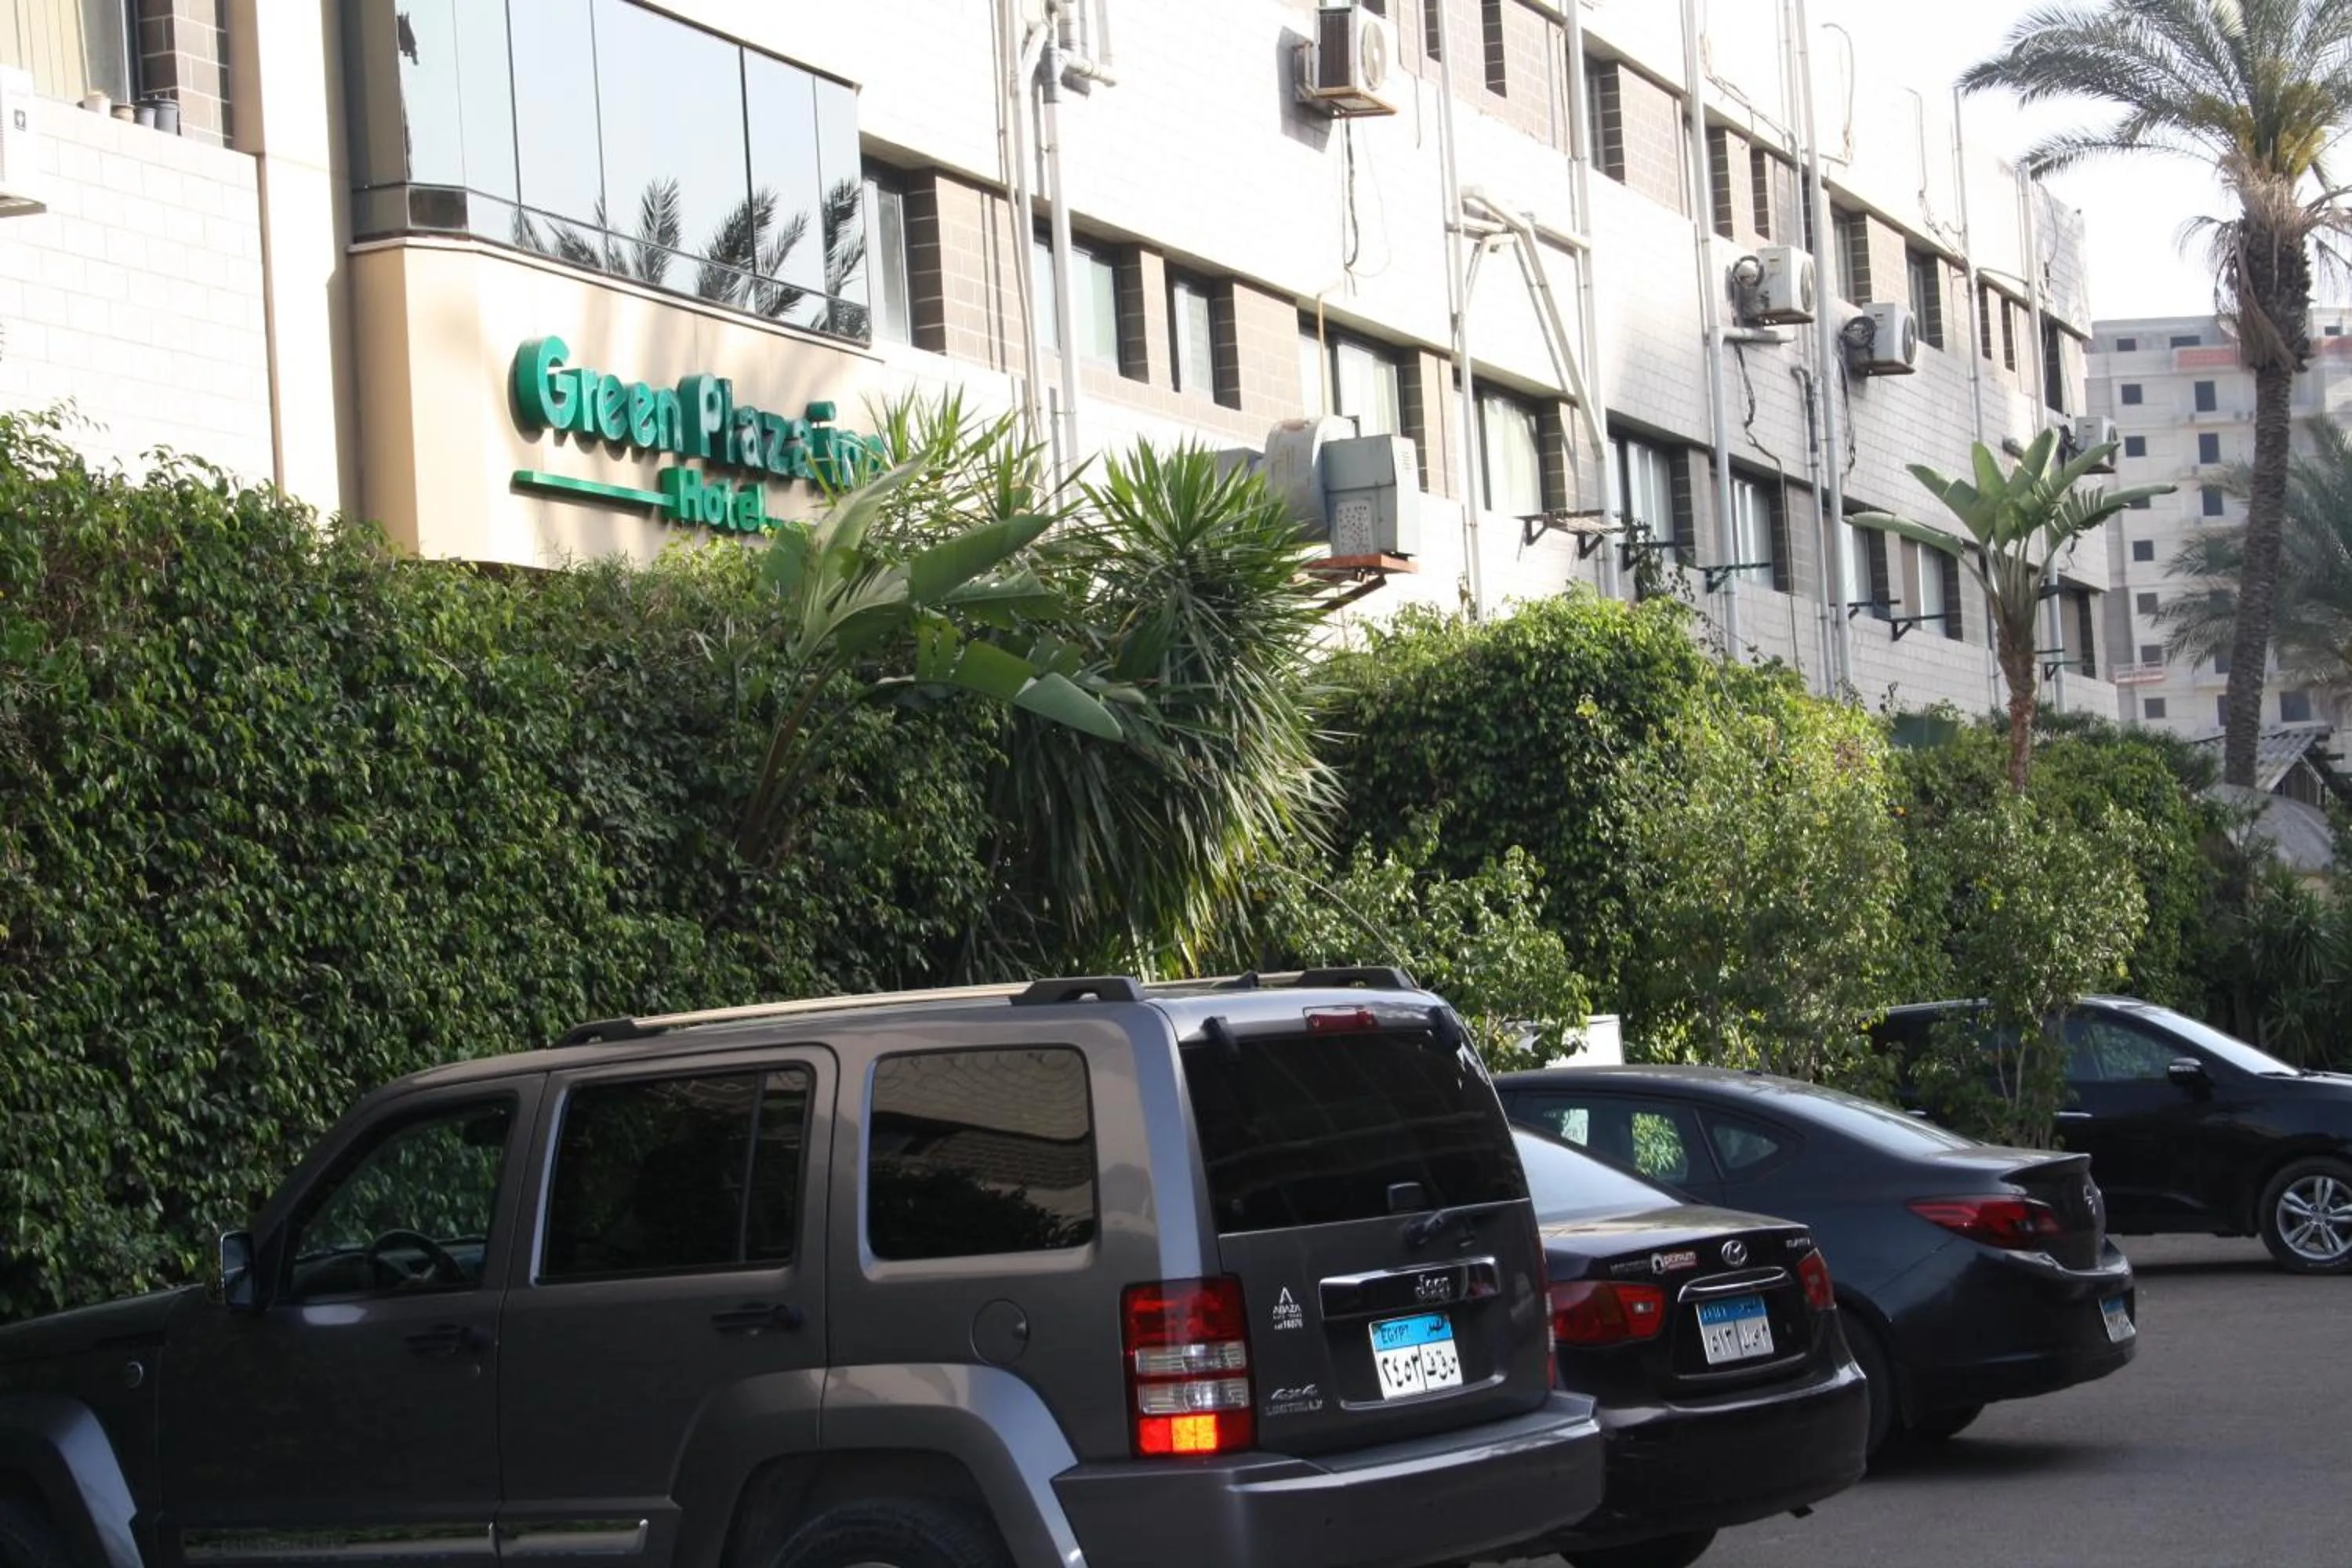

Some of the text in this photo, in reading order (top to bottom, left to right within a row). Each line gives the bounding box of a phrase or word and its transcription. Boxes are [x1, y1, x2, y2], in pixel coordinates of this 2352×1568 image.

[514, 335, 684, 452] Green
[674, 372, 817, 480] Plaza
[660, 465, 767, 534] Hotel
[1380, 1323, 1410, 1343] EGYPT
